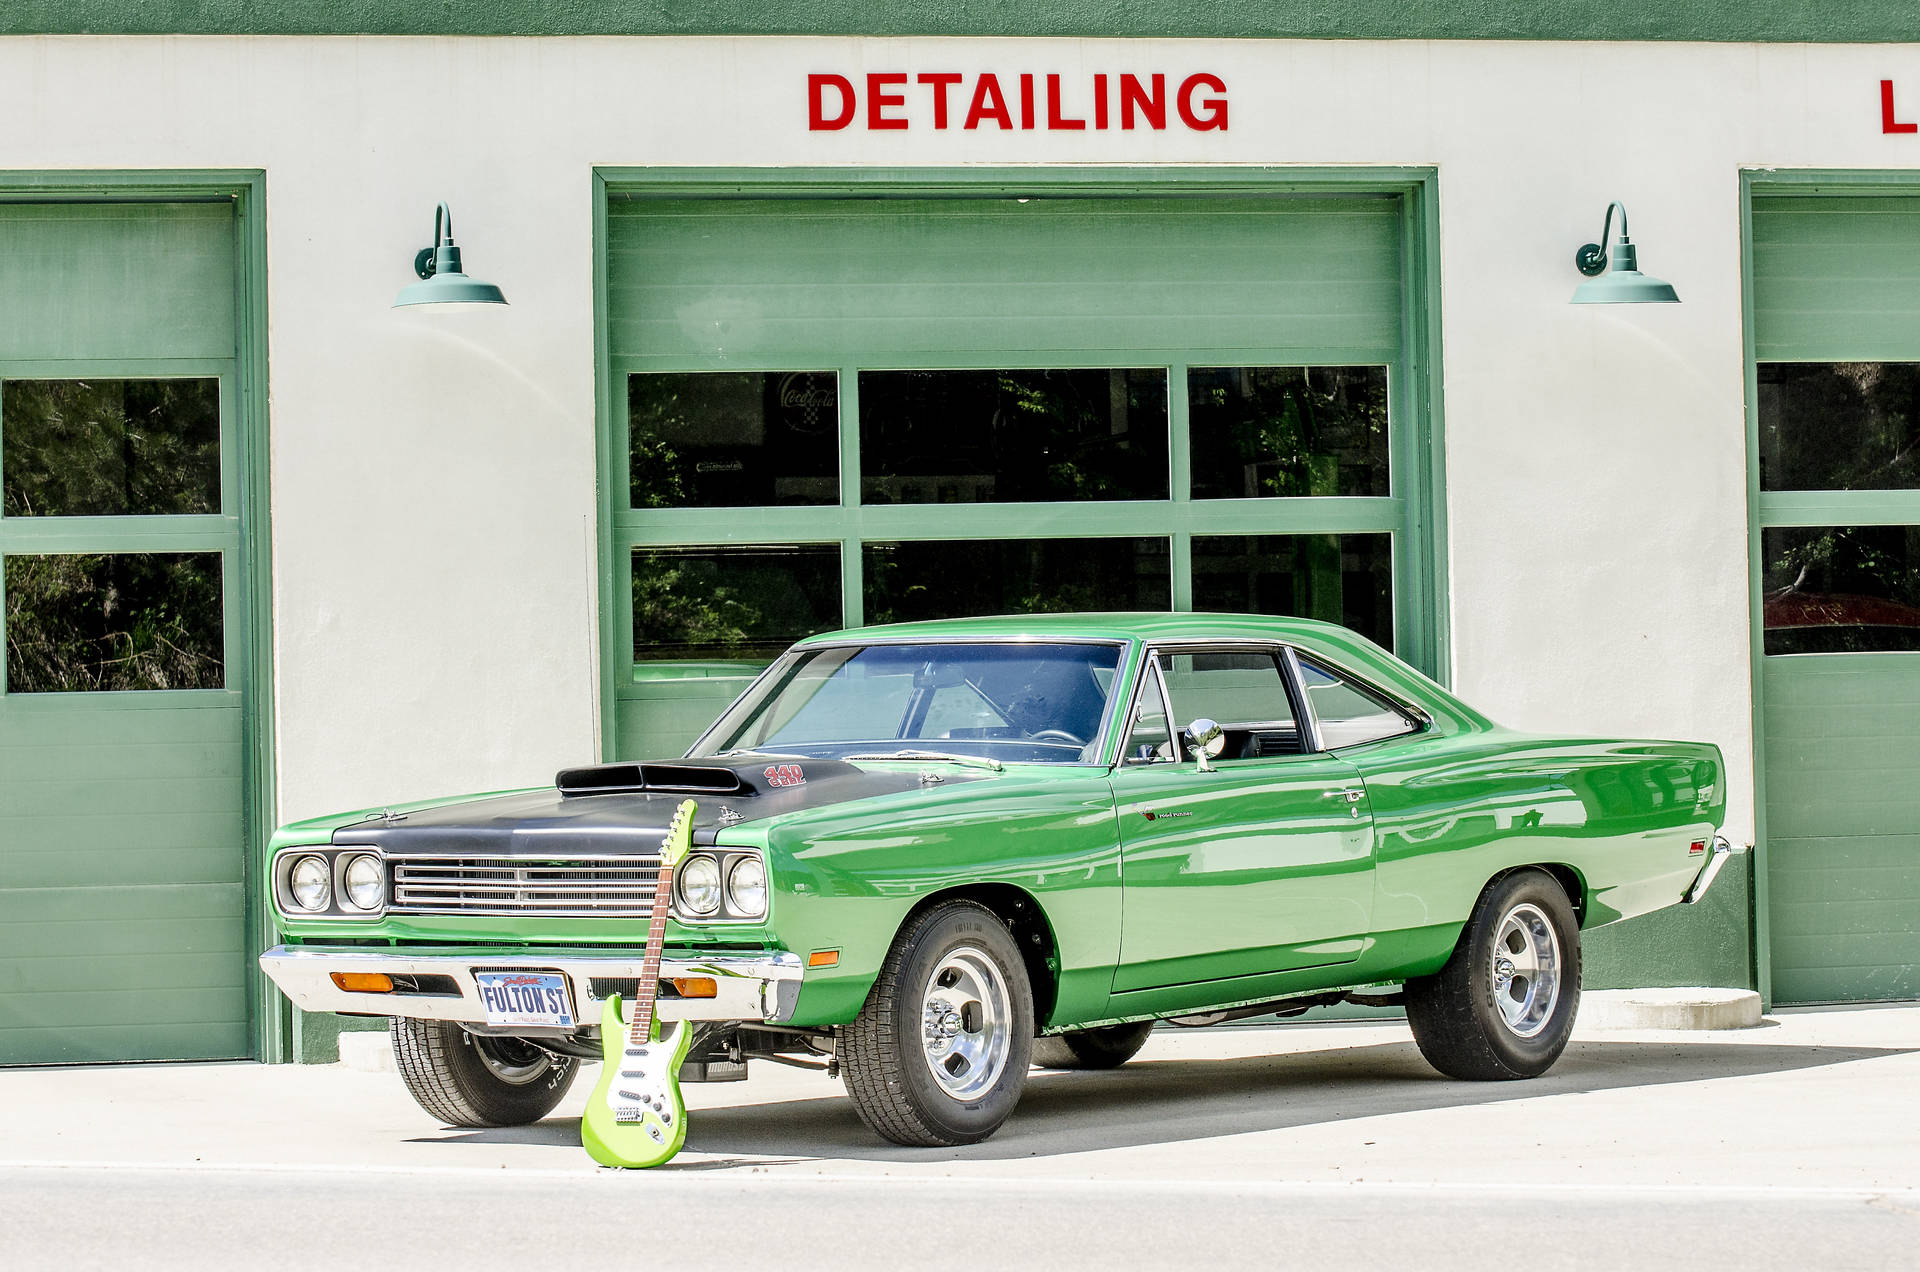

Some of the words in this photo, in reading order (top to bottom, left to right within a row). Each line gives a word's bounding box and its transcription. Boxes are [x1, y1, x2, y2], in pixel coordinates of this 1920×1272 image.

[808, 73, 1228, 131] DETAILING
[763, 765, 803, 781] 440
[483, 986, 546, 1013] FULTON
[546, 987, 567, 1015] ST
